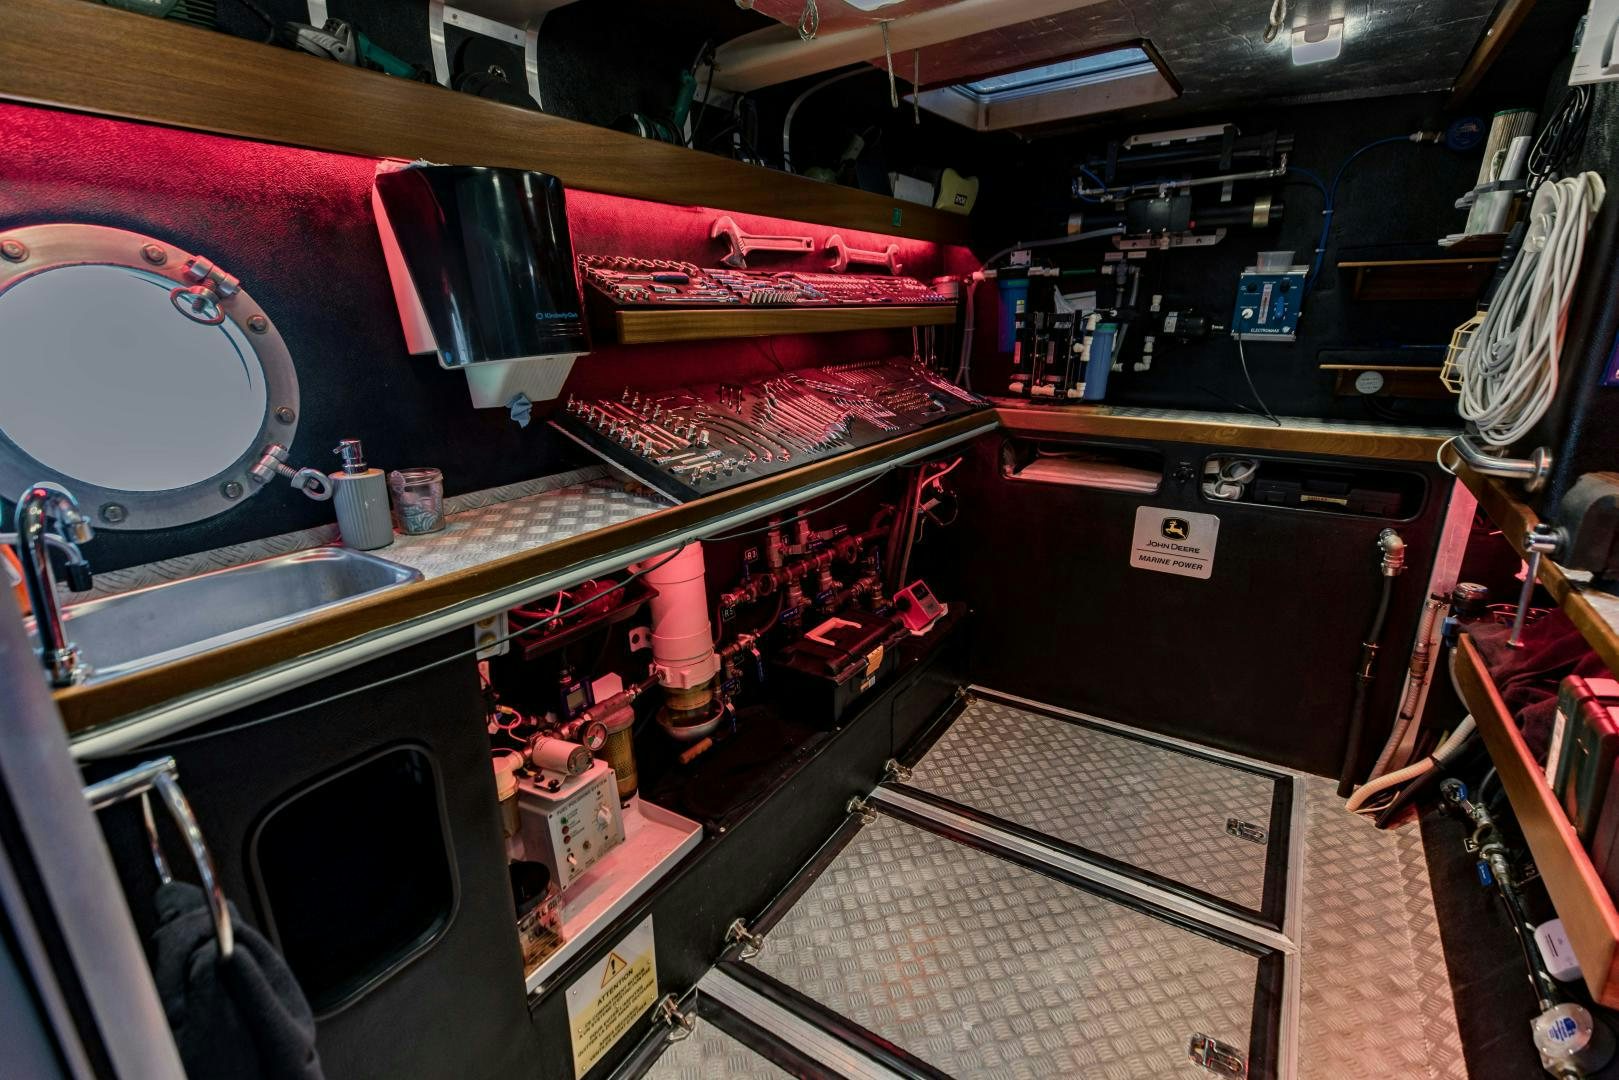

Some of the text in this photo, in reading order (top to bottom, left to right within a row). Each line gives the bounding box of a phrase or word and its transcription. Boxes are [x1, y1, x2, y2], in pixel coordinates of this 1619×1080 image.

[1147, 540, 1200, 553] JOHN DEERE
[1139, 554, 1203, 570] MARINE POWER
[597, 967, 632, 1006] ATTENTION
